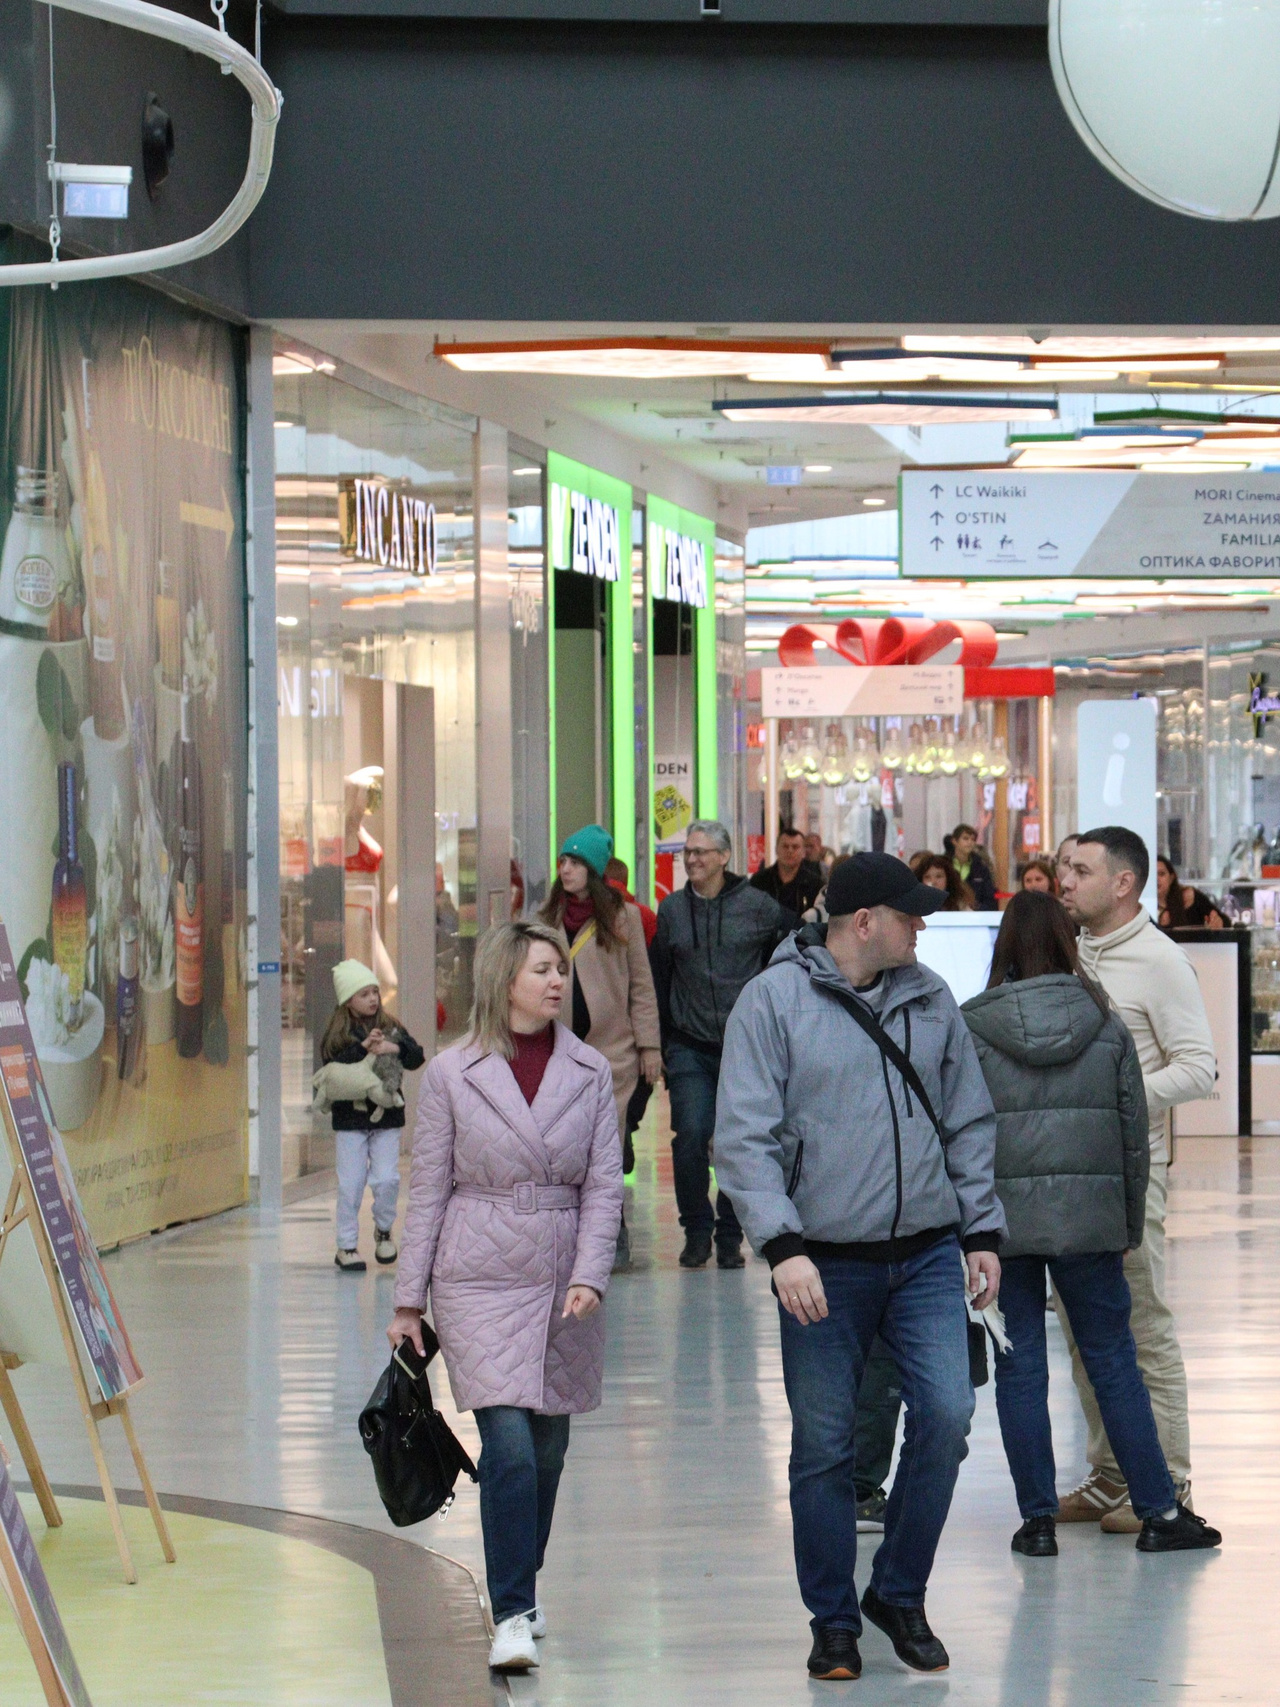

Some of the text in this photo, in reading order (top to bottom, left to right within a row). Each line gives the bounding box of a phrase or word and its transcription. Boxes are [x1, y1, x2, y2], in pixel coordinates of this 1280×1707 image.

[955, 485, 1027, 498] LC Waikiki
[1194, 489, 1233, 502] MORI
[955, 511, 1007, 525] O'STIN
[354, 478, 438, 576] INCANTO
[1139, 556, 1205, 569] ОПТИКА
[653, 762, 688, 775] DEN
